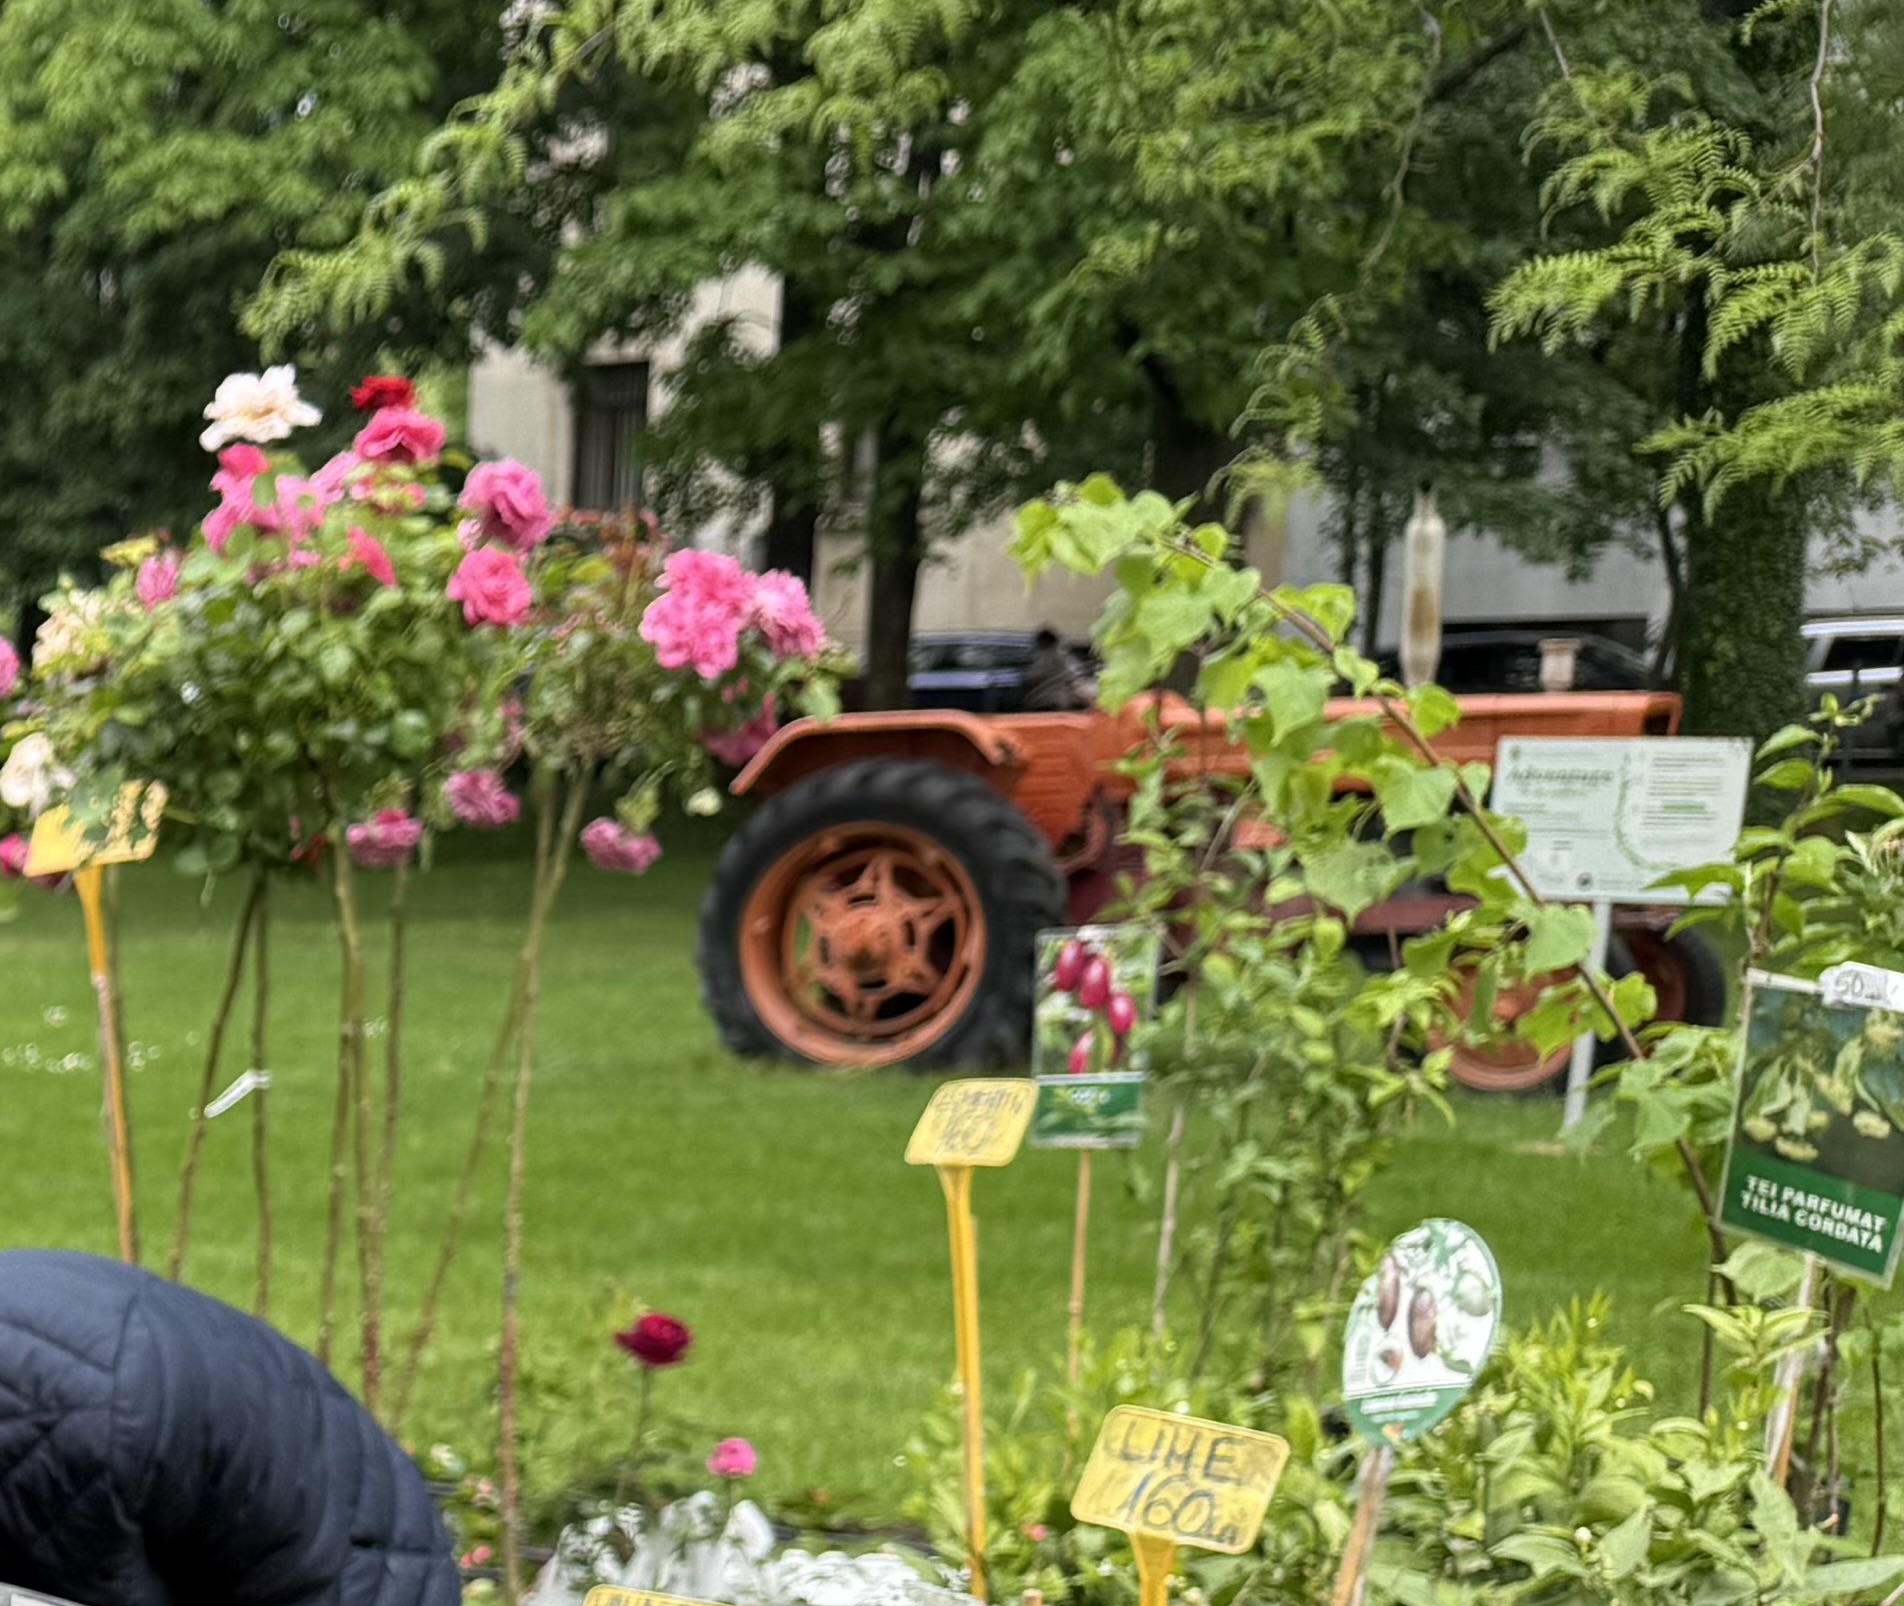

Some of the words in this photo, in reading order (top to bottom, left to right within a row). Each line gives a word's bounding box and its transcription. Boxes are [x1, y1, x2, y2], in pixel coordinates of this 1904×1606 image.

[1740, 1190, 1791, 1223] TILIA
[1794, 1208, 1883, 1254] CORDATA
[1745, 1174, 1778, 1197] TEI
[1782, 1186, 1888, 1233] PARFUMAT
[1118, 1420, 1245, 1486] LIME
[1117, 1471, 1218, 1538] 160
